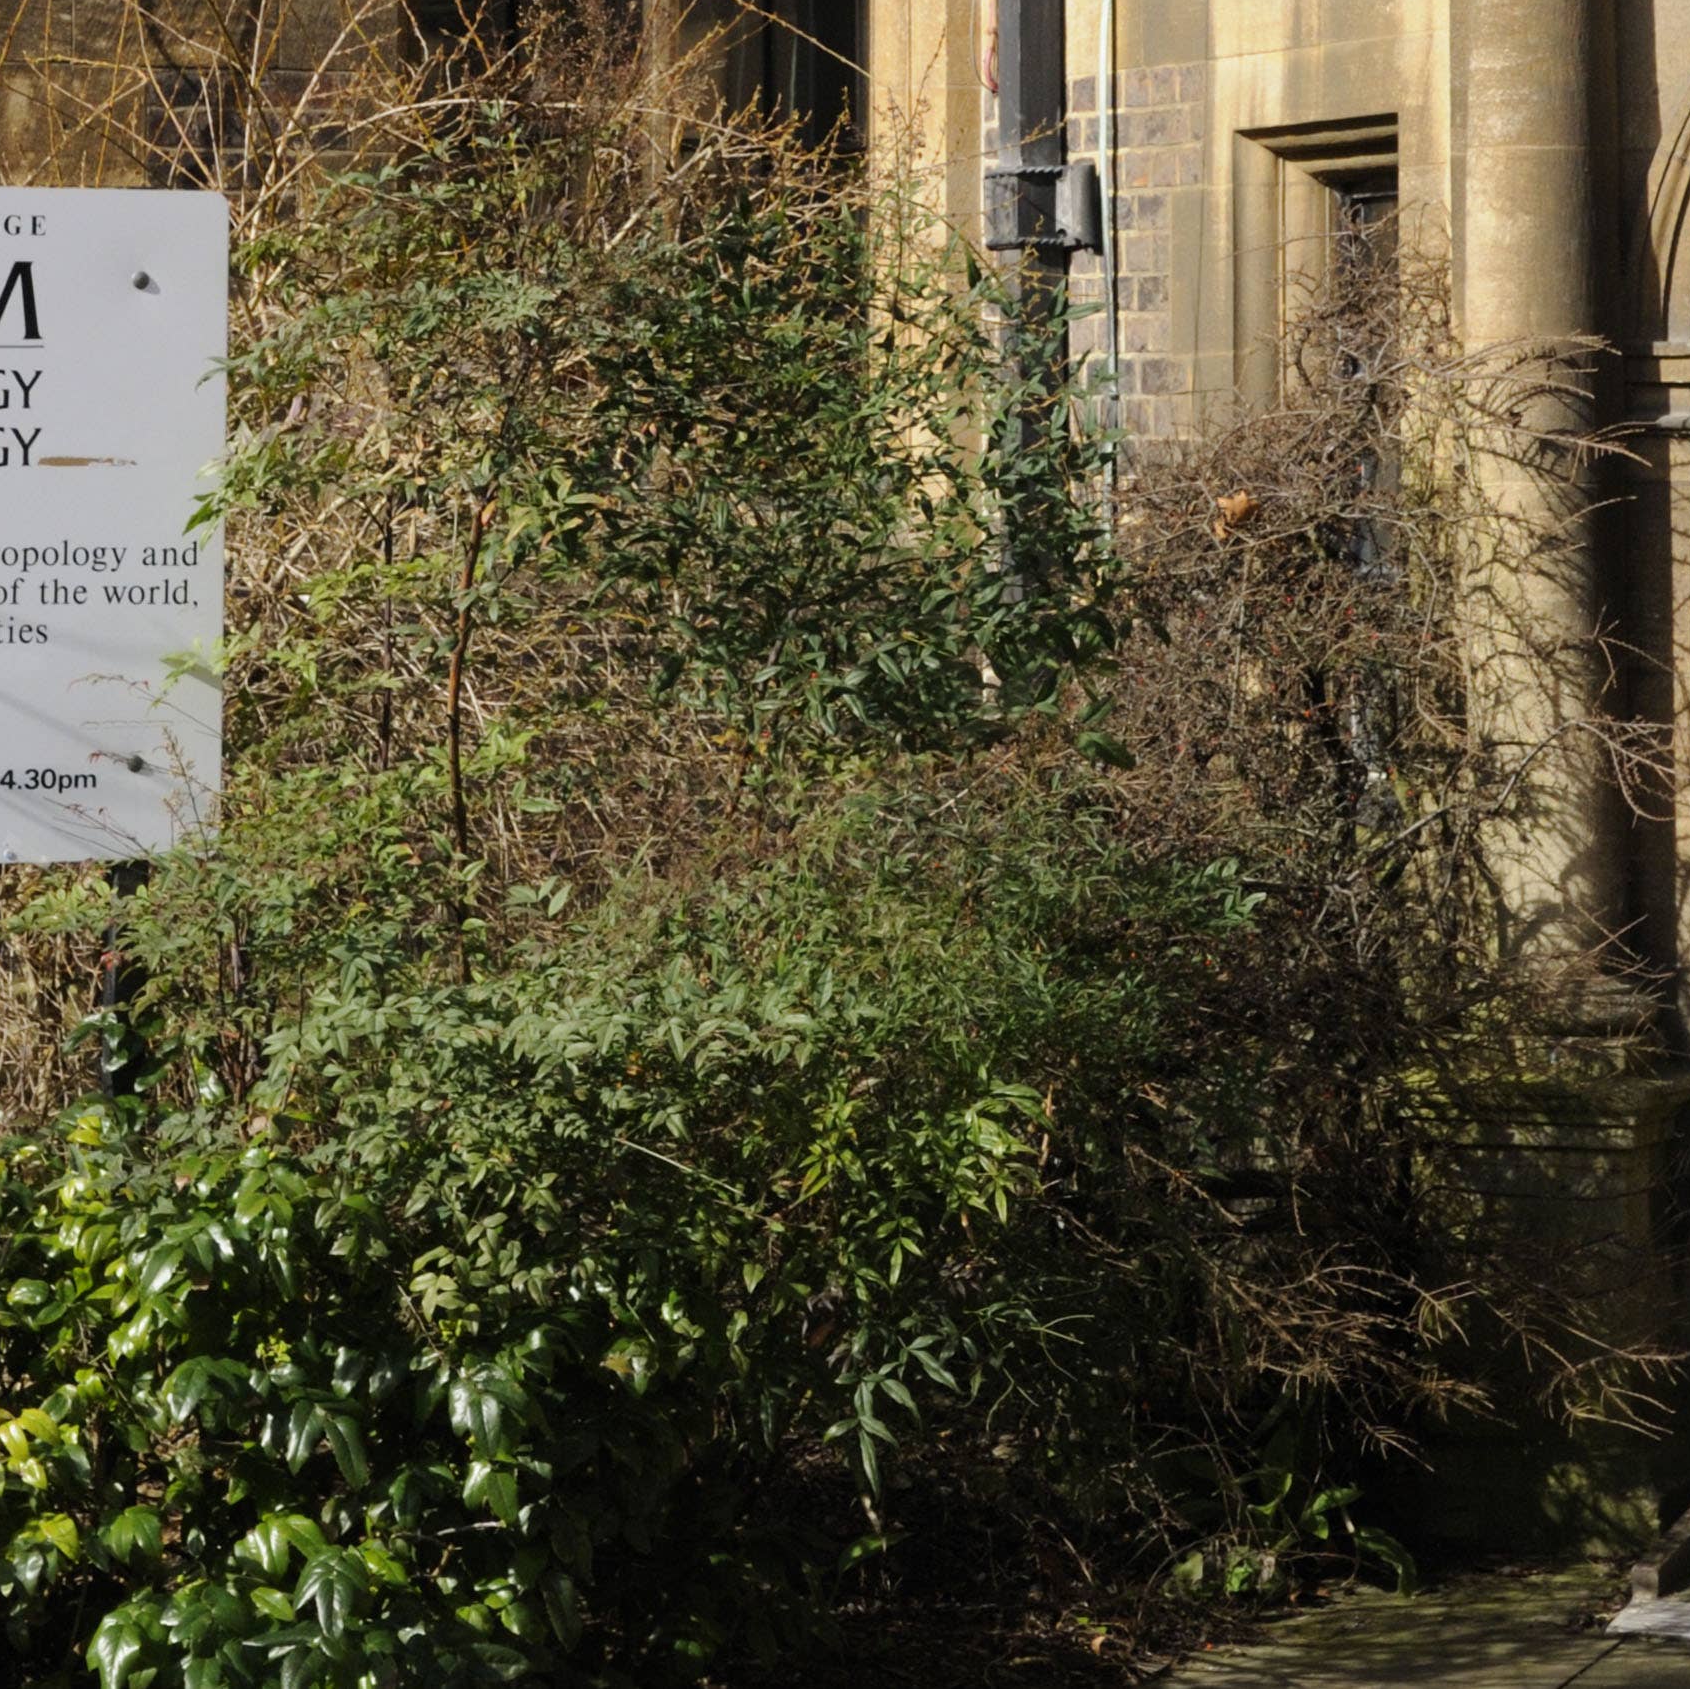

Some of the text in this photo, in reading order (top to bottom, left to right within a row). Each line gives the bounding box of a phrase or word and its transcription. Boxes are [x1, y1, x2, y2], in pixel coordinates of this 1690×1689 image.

[141, 540, 199, 567] and
[39, 578, 88, 605] the
[102, 578, 199, 608] world,
[0, 768, 98, 794] 4.30pm
